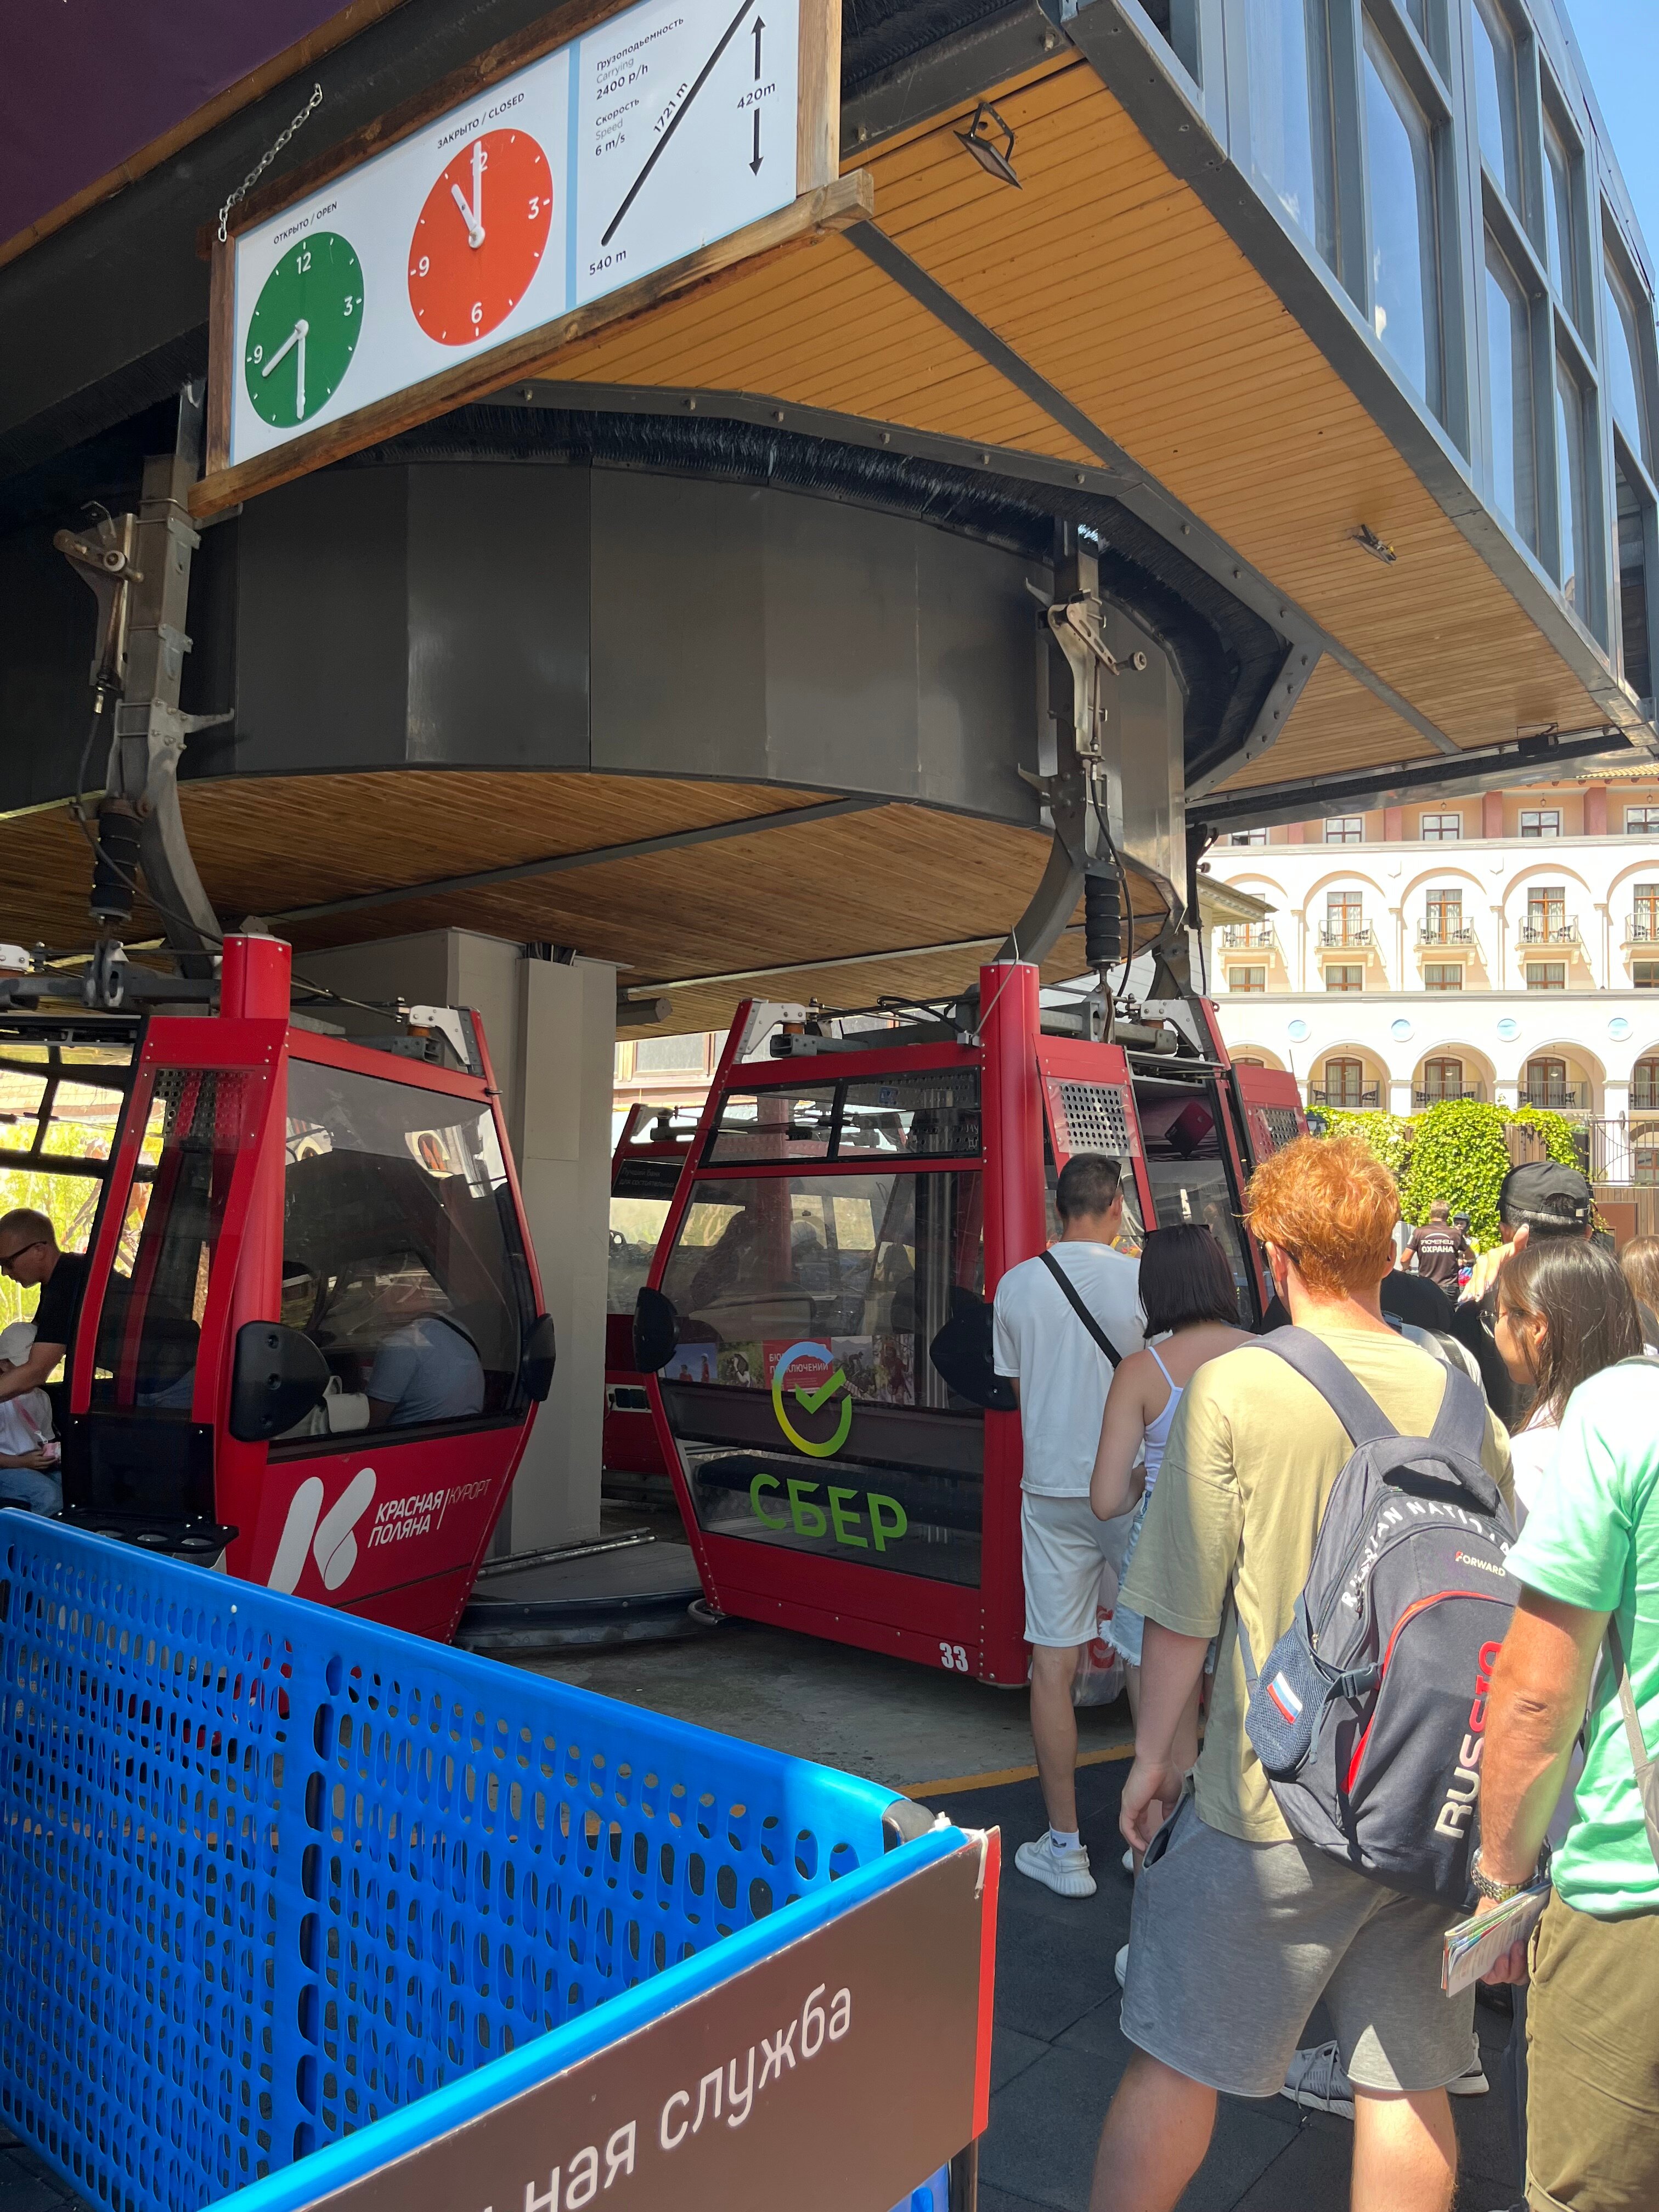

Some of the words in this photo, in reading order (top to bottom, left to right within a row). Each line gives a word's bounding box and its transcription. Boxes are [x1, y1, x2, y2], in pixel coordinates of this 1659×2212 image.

[596, 57, 634, 83] Carrying
[596, 76, 625, 100] 2400
[628, 64, 648, 84] p/h
[653, 100, 676, 133] 1721
[676, 82, 688, 98] m
[737, 83, 776, 109] 420m
[437, 119, 479, 149] ЗАКРЫТО
[488, 93, 524, 119] CLOSED
[596, 99, 640, 126] Скорость
[595, 119, 623, 140] Speed
[595, 145, 602, 156] 6
[605, 132, 625, 151] m/s
[528, 196, 539, 219] 3
[273, 218, 309, 244] ОТКРЫТО
[317, 201, 337, 219] OPEN
[296, 251, 312, 275] 12
[419, 256, 430, 277] 9
[589, 256, 612, 275] 540
[616, 250, 626, 263] m
[344, 295, 353, 317] 3
[471, 301, 483, 324] 6
[253, 345, 263, 364] 9
[1421, 1245, 1454, 1254] ОХРАНА
[375, 1489, 444, 1525] КРАСНАЯ
[448, 1479, 492, 1505] КУРОРТ
[750, 1474, 908, 1551] СБЕР
[368, 1514, 431, 1548] ПОЛЯНА
[1455, 1550, 1506, 1577] FORWARD
[939, 1642, 969, 1672] 33
[660, 1982, 851, 2149] служба
